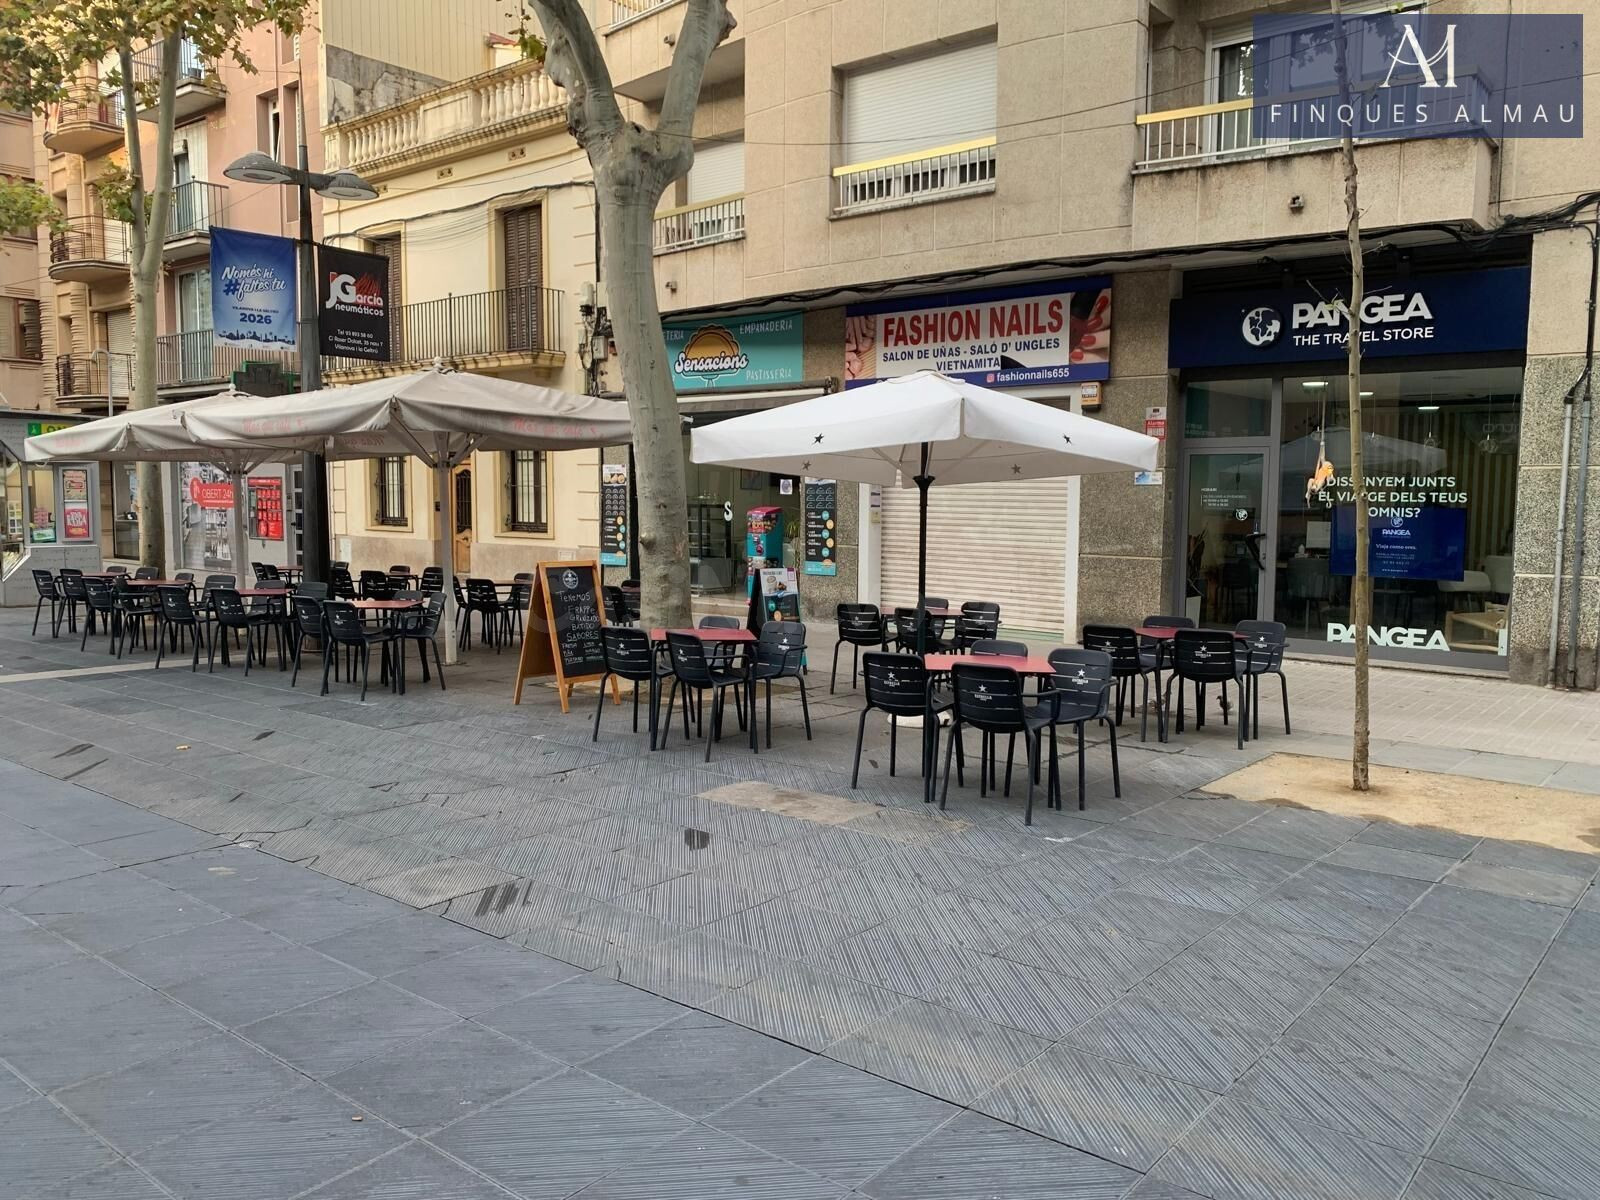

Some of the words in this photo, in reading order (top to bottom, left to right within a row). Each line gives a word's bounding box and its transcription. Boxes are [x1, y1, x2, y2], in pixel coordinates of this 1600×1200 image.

[221, 263, 261, 280] Només
[271, 277, 287, 290] tu
[335, 303, 384, 317] neumáticos
[1292, 292, 1433, 329] PANGEA
[239, 312, 273, 325] 2026
[883, 309, 980, 348] FASHION
[989, 299, 1063, 338] NAILS
[739, 319, 793, 335] EMPANADERIA
[1293, 334, 1320, 346] THE
[1382, 326, 1435, 341] STORE
[882, 350, 914, 362] SALON
[917, 349, 930, 359] DE
[932, 345, 961, 358] UÑAS
[970, 341, 998, 356] SALÓ
[1015, 337, 1060, 352] UNGLES
[674, 351, 749, 374] Sensacions
[936, 357, 1001, 371] VIETNAMITA
[746, 367, 792, 382] PASTISSERIA
[997, 367, 1070, 383] fashionnails655
[1326, 476, 1405, 487] DISSNYEM
[1408, 477, 1456, 488] JUNTS
[201, 488, 221, 499] OBERT
[1318, 491, 1334, 501] EL
[1337, 492, 1386, 502] VIAGE
[1390, 492, 1427, 503] DELS
[1429, 492, 1468, 504] TEUS
[1368, 506, 1421, 518] OMNIS?
[1326, 622, 1451, 651] PANGEA
